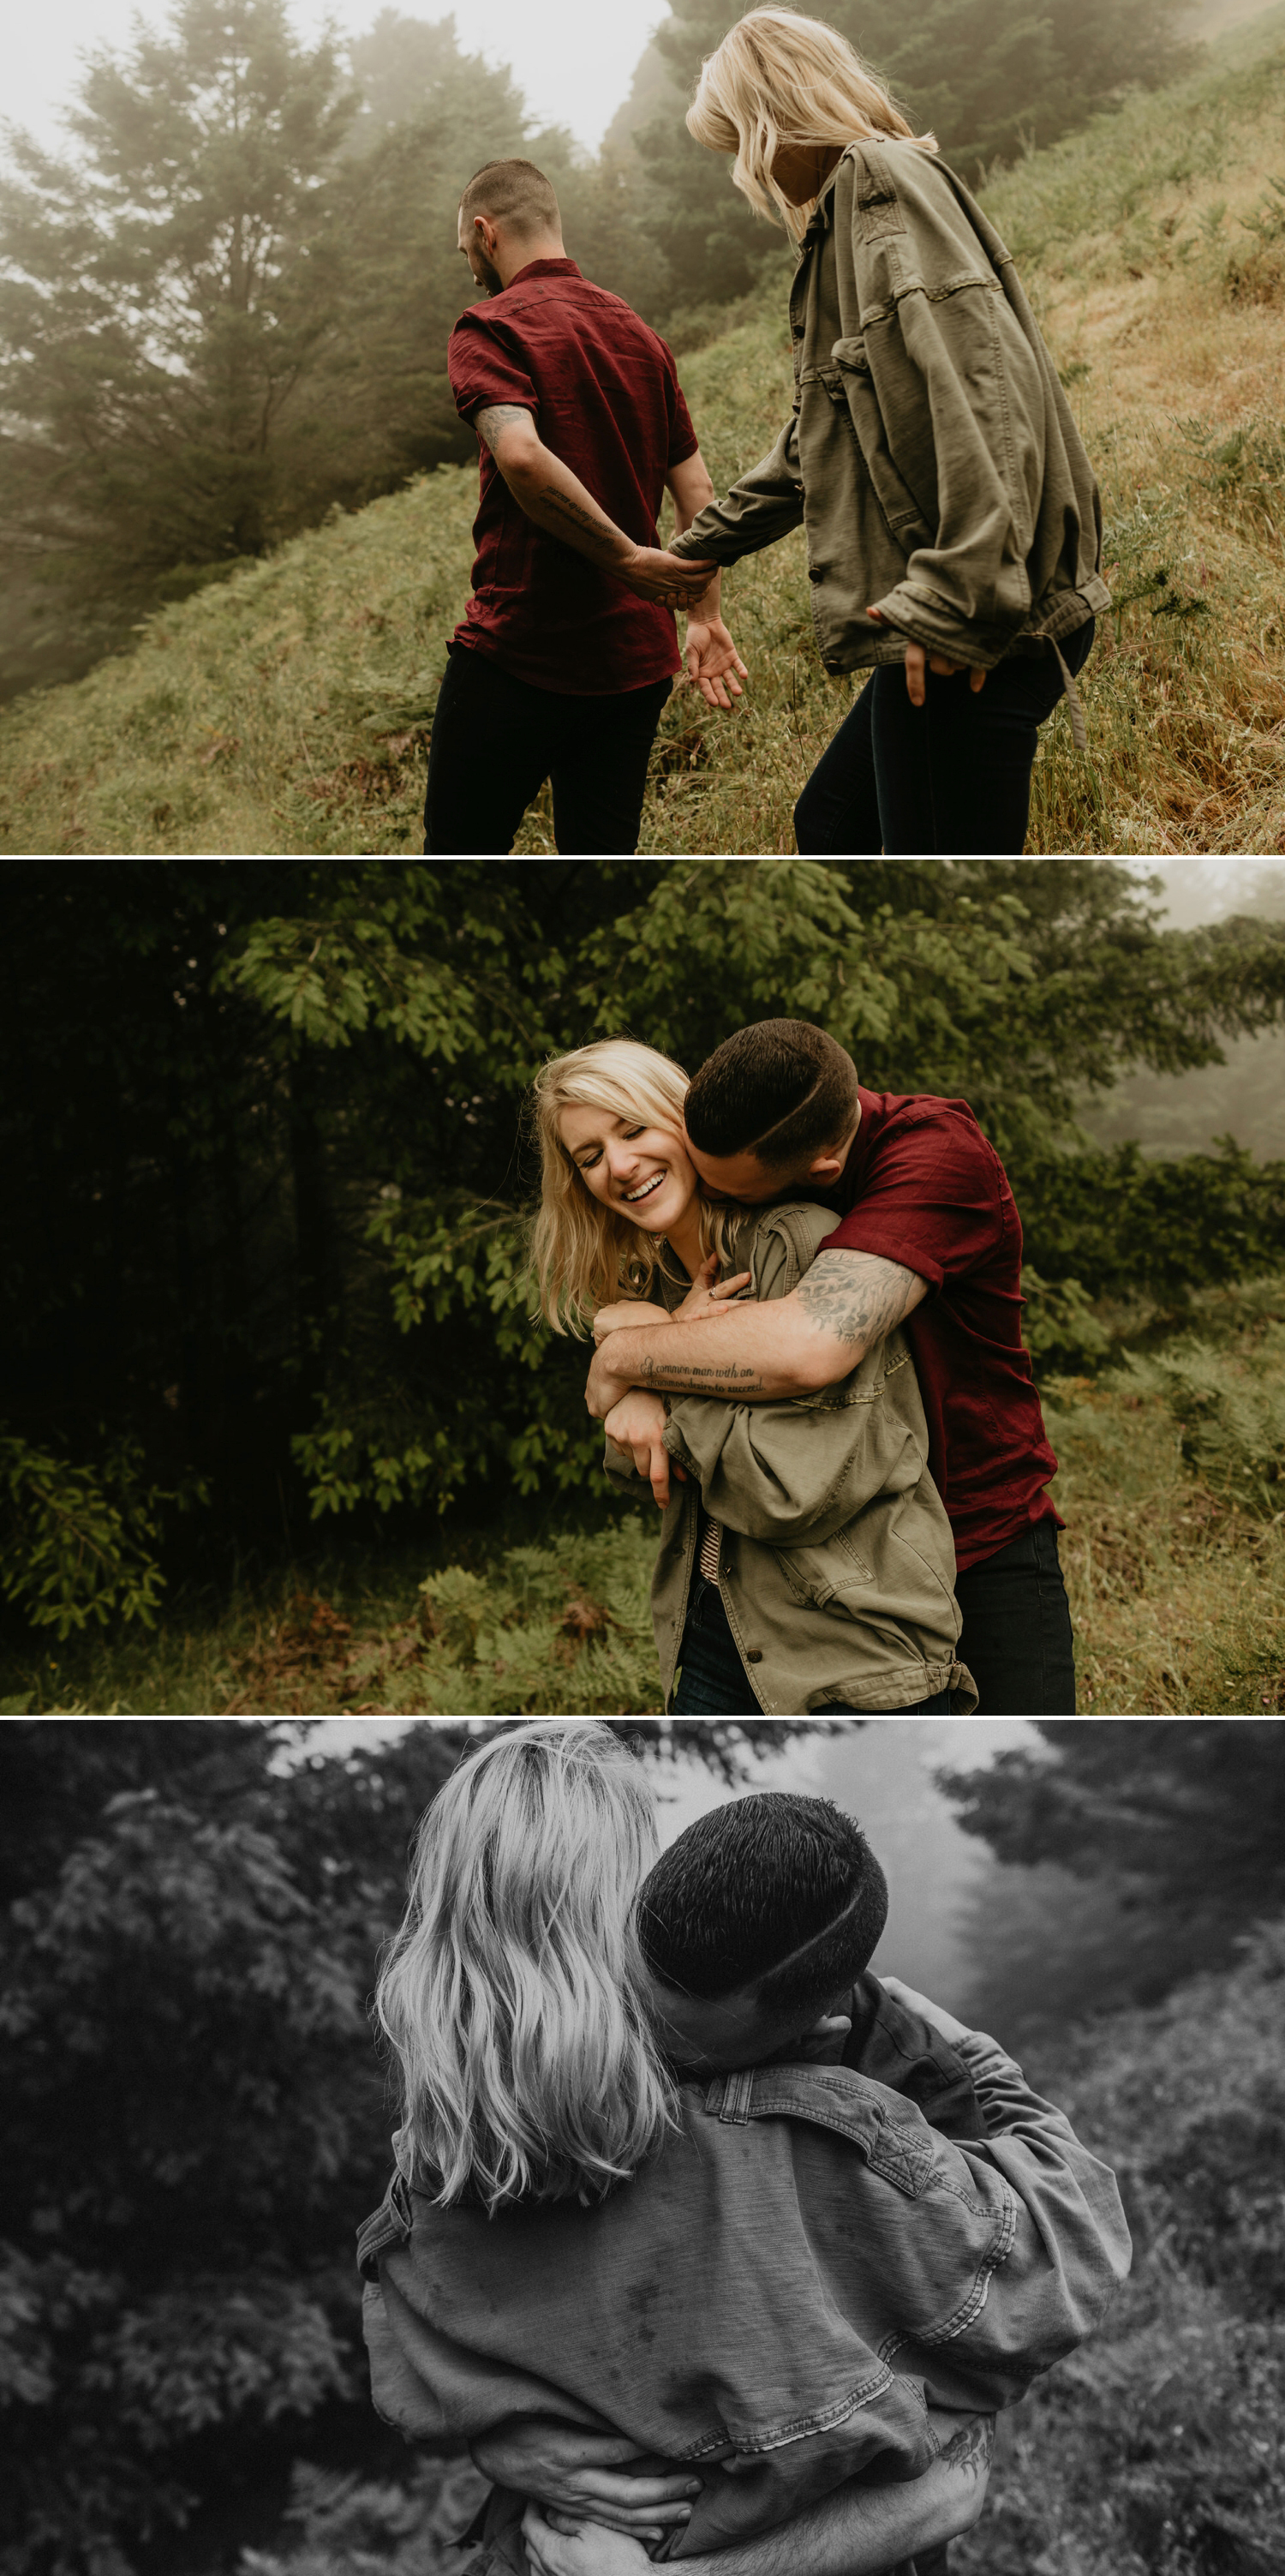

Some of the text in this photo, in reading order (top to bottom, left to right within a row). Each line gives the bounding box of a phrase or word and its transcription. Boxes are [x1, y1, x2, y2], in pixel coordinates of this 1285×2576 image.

[640, 1356, 754, 1378] A common man with an
[687, 1378, 714, 1391] desire
[715, 1384, 725, 1393] to
